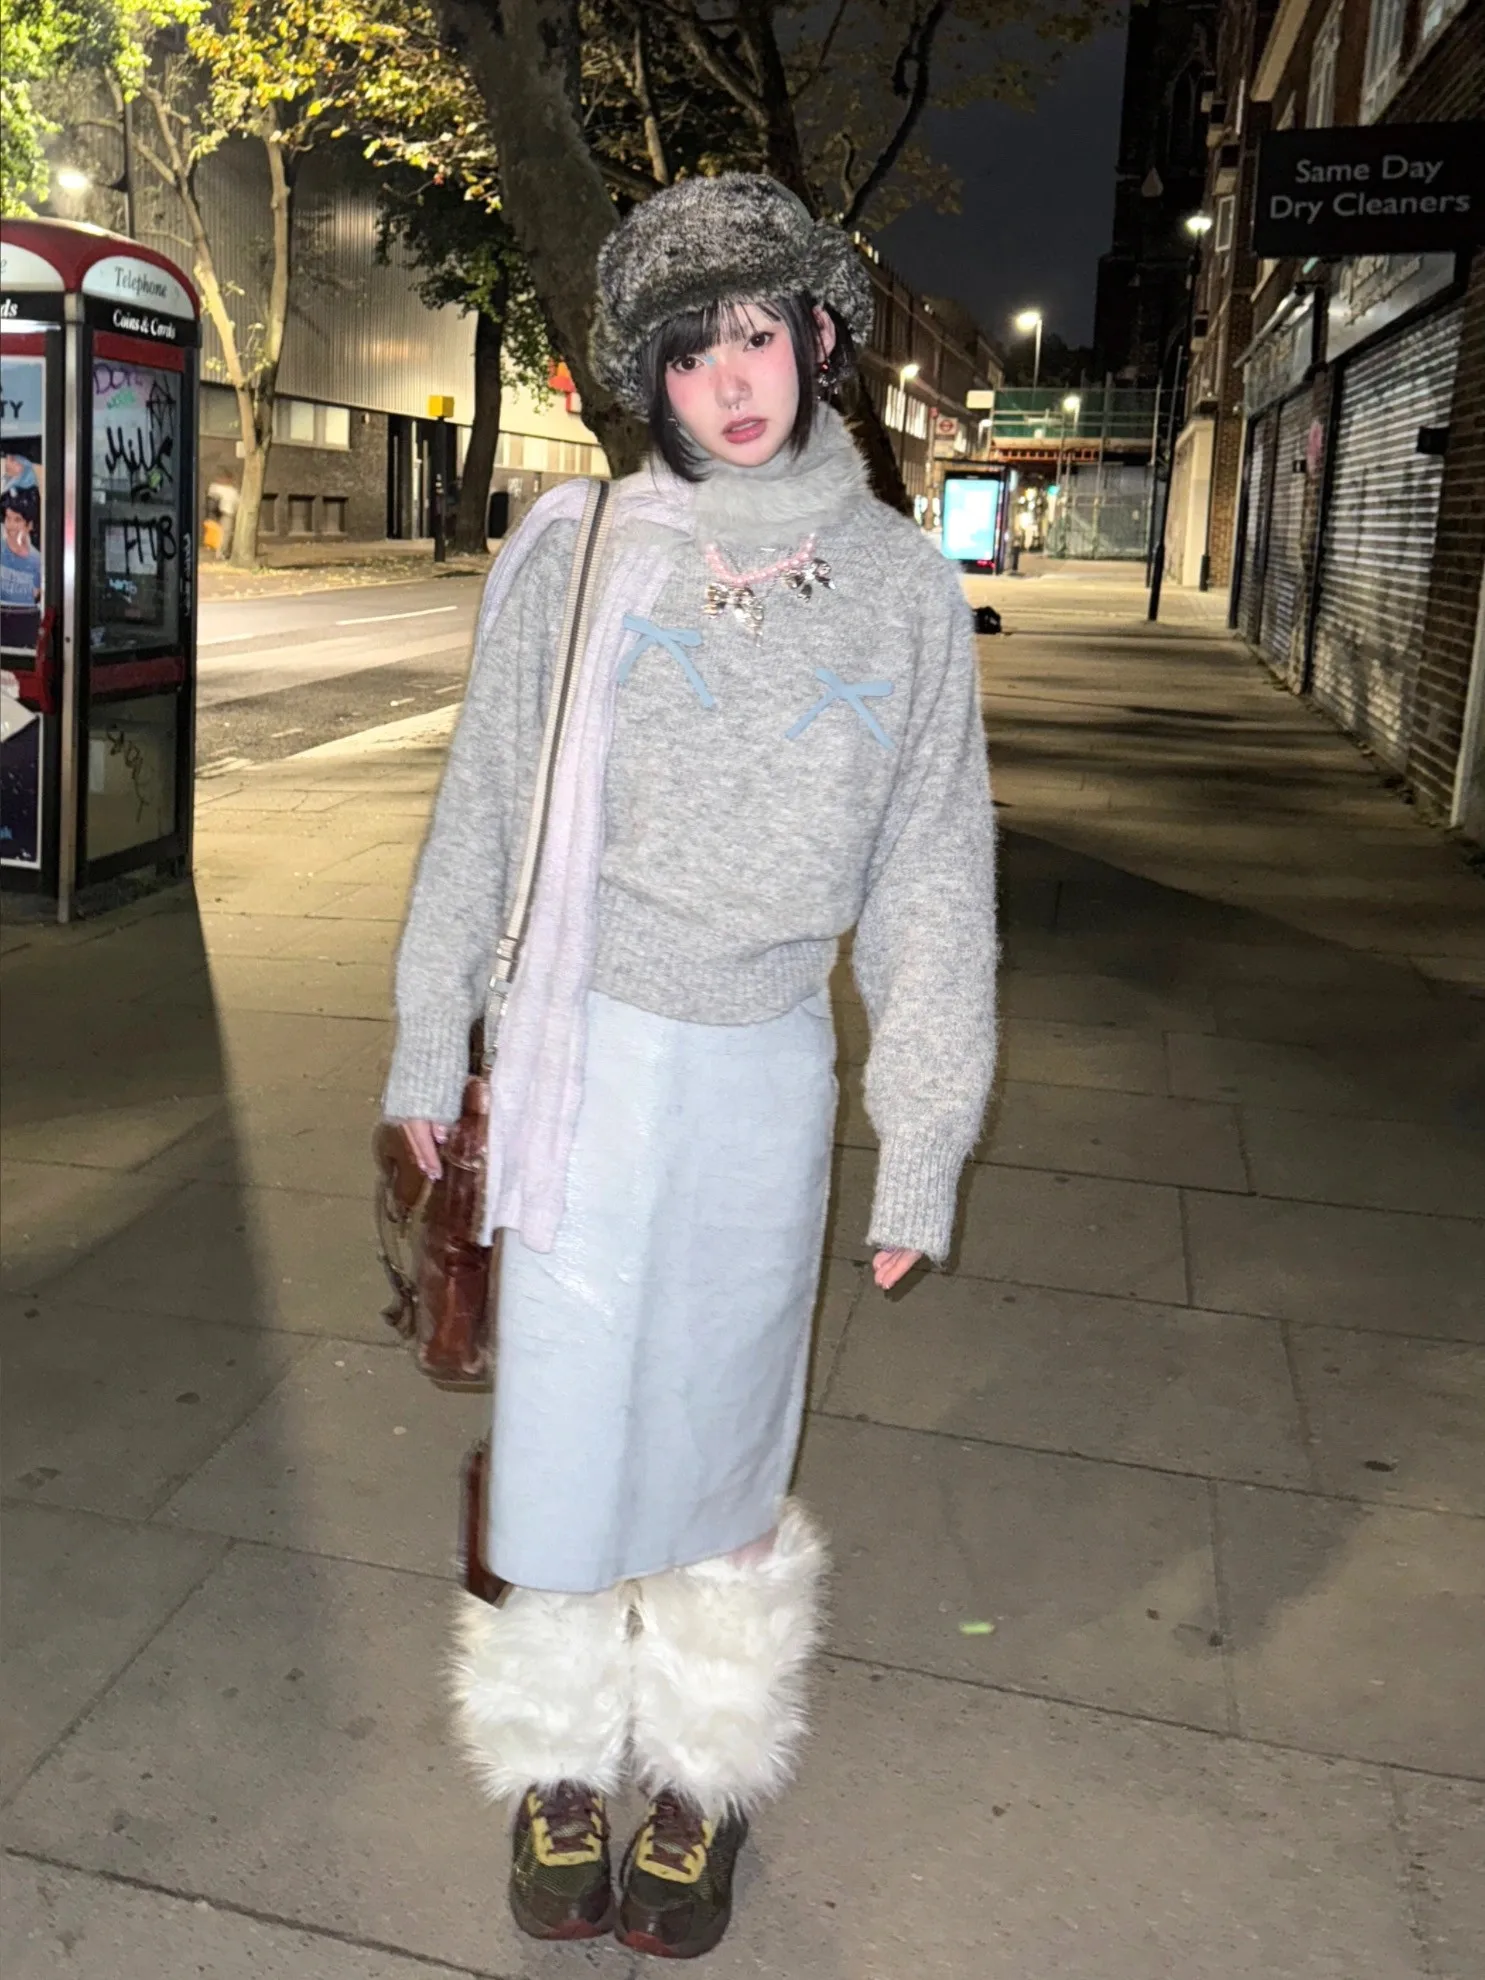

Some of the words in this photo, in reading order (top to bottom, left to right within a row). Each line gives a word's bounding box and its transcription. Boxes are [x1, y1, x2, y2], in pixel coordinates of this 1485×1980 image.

[1294, 159, 1370, 183] Same
[1381, 154, 1444, 184] Day
[1269, 195, 1324, 225] Dry
[1332, 192, 1472, 217] Cleaners
[114, 265, 168, 298] Telephone
[112, 308, 140, 331] Coins
[140, 315, 149, 334] &
